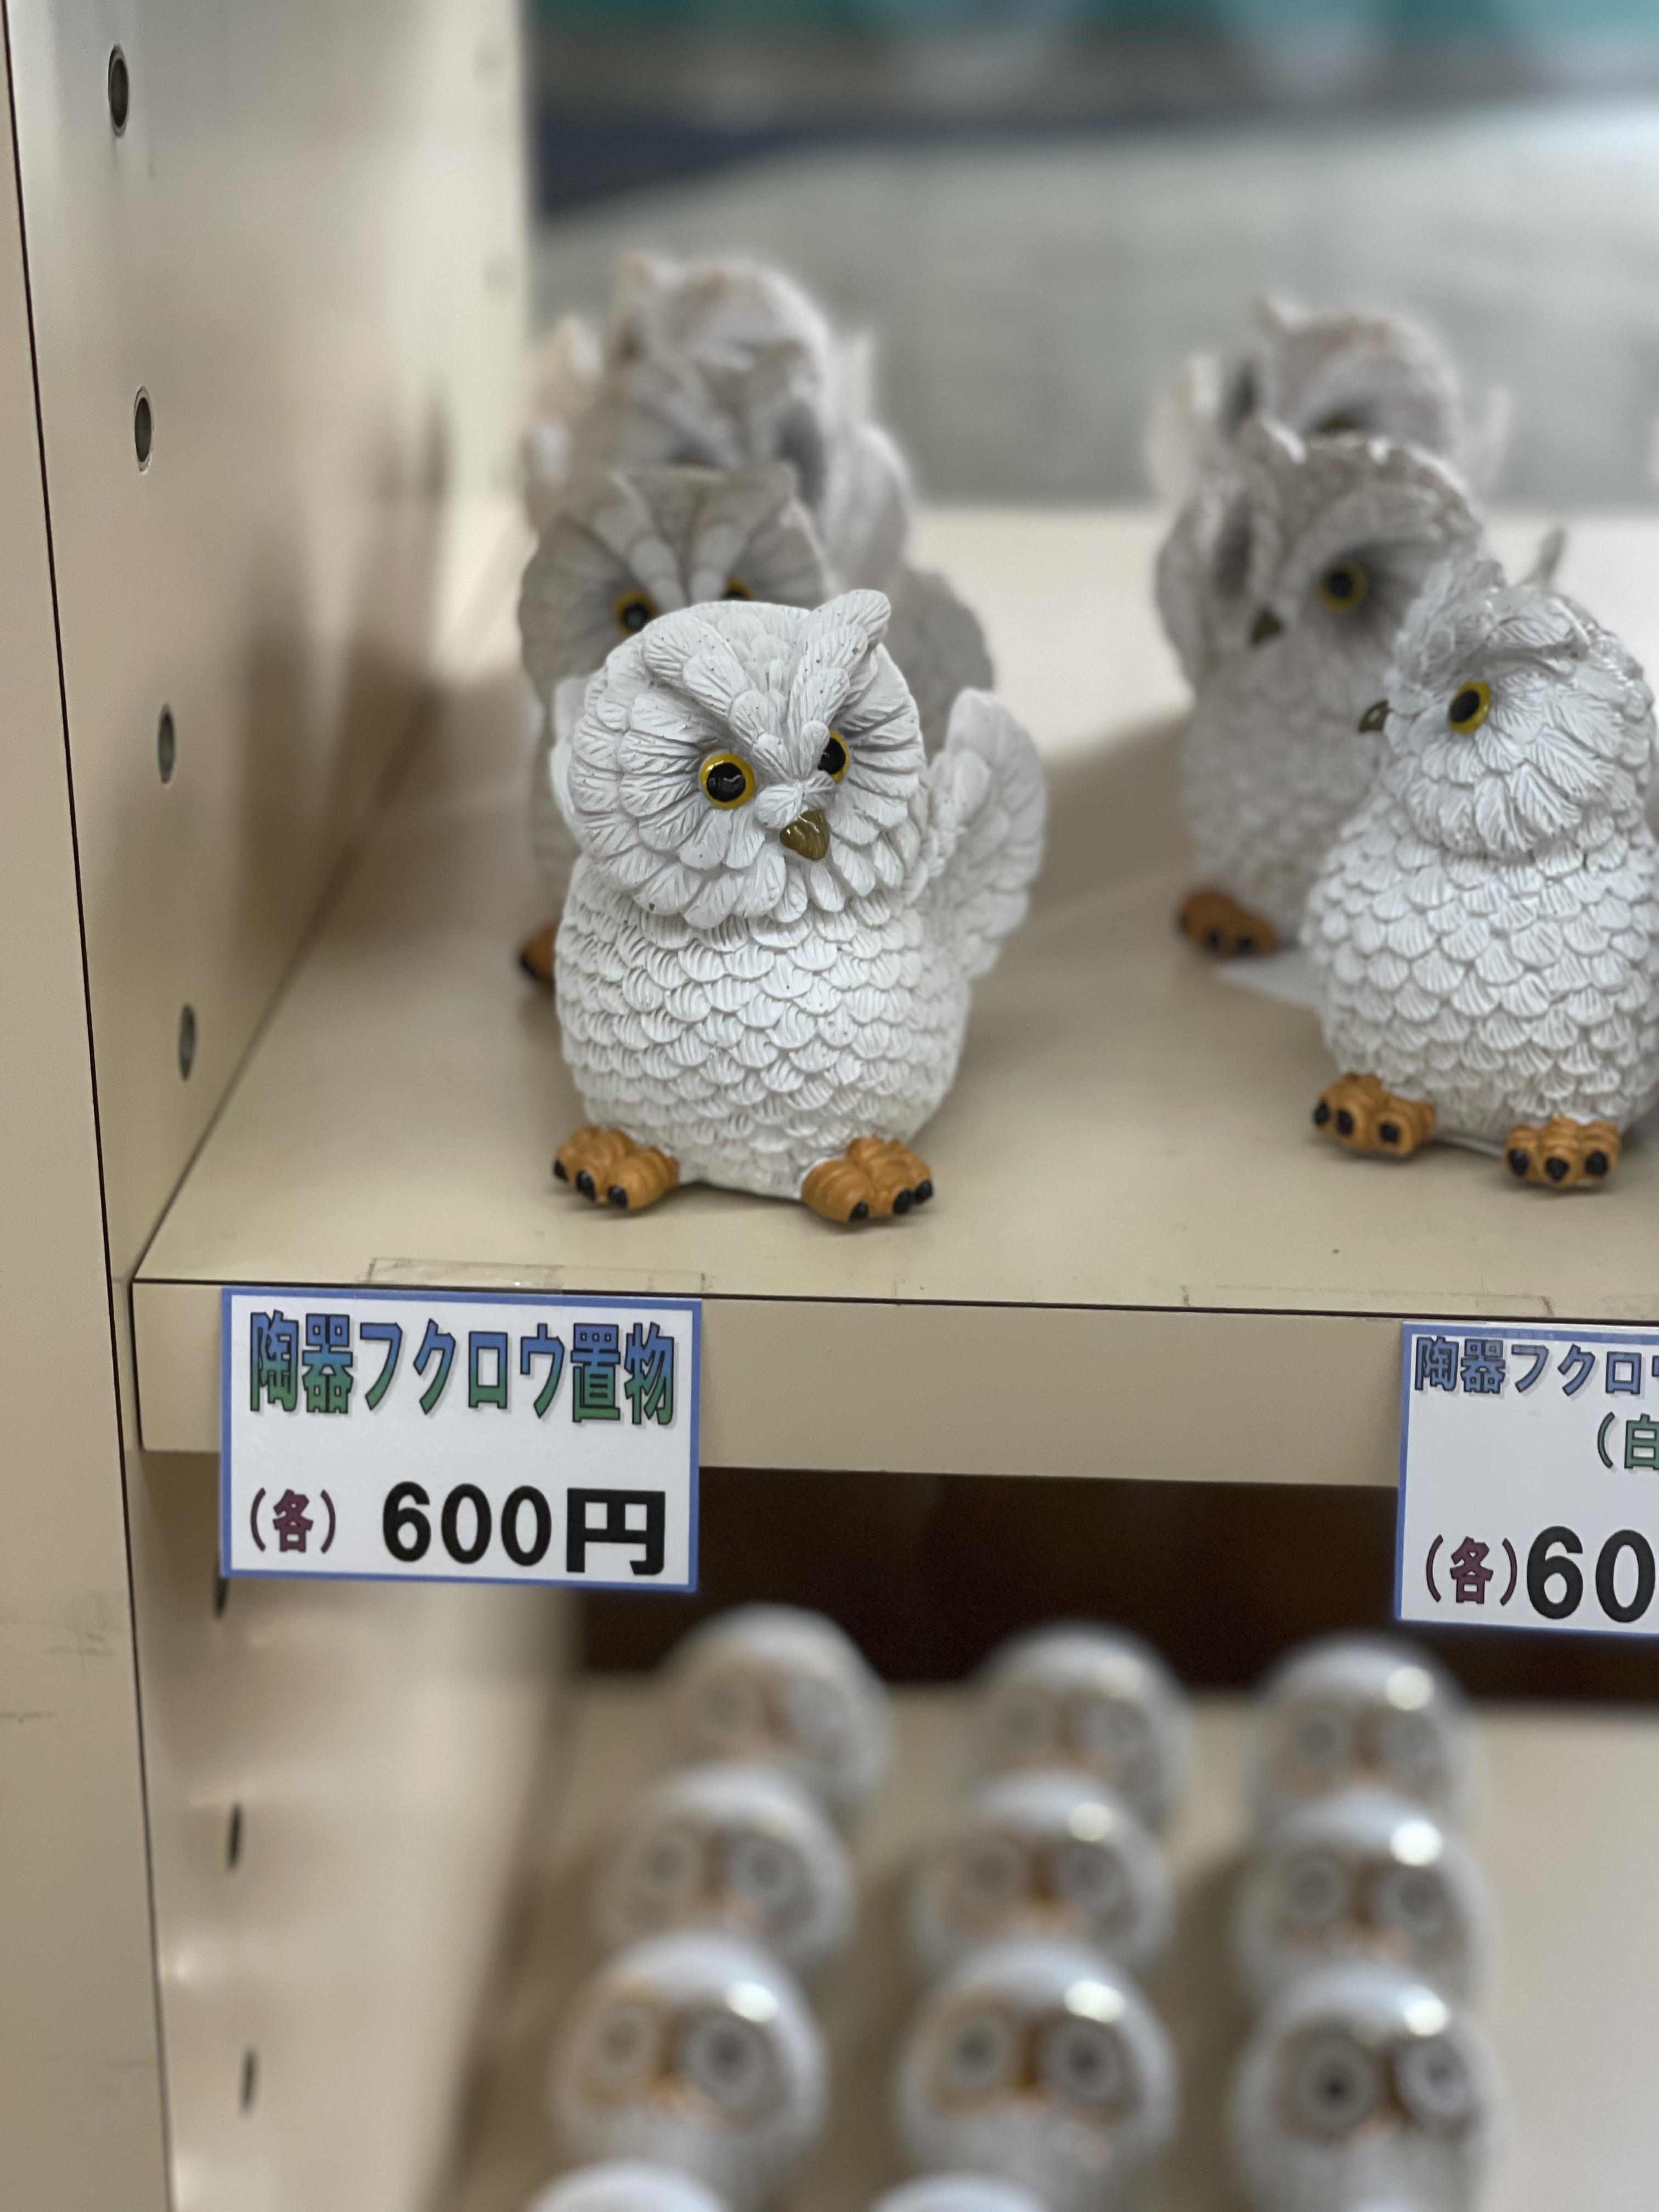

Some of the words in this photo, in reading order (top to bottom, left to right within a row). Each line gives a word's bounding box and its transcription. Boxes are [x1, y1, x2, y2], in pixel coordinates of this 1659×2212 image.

[250, 1310, 675, 1425] 陶器フクロウ置物
[1415, 1336, 1659, 1396] 陶器フクロ
[251, 1488, 336, 1553] (各)
[382, 1481, 665, 1576] 600円
